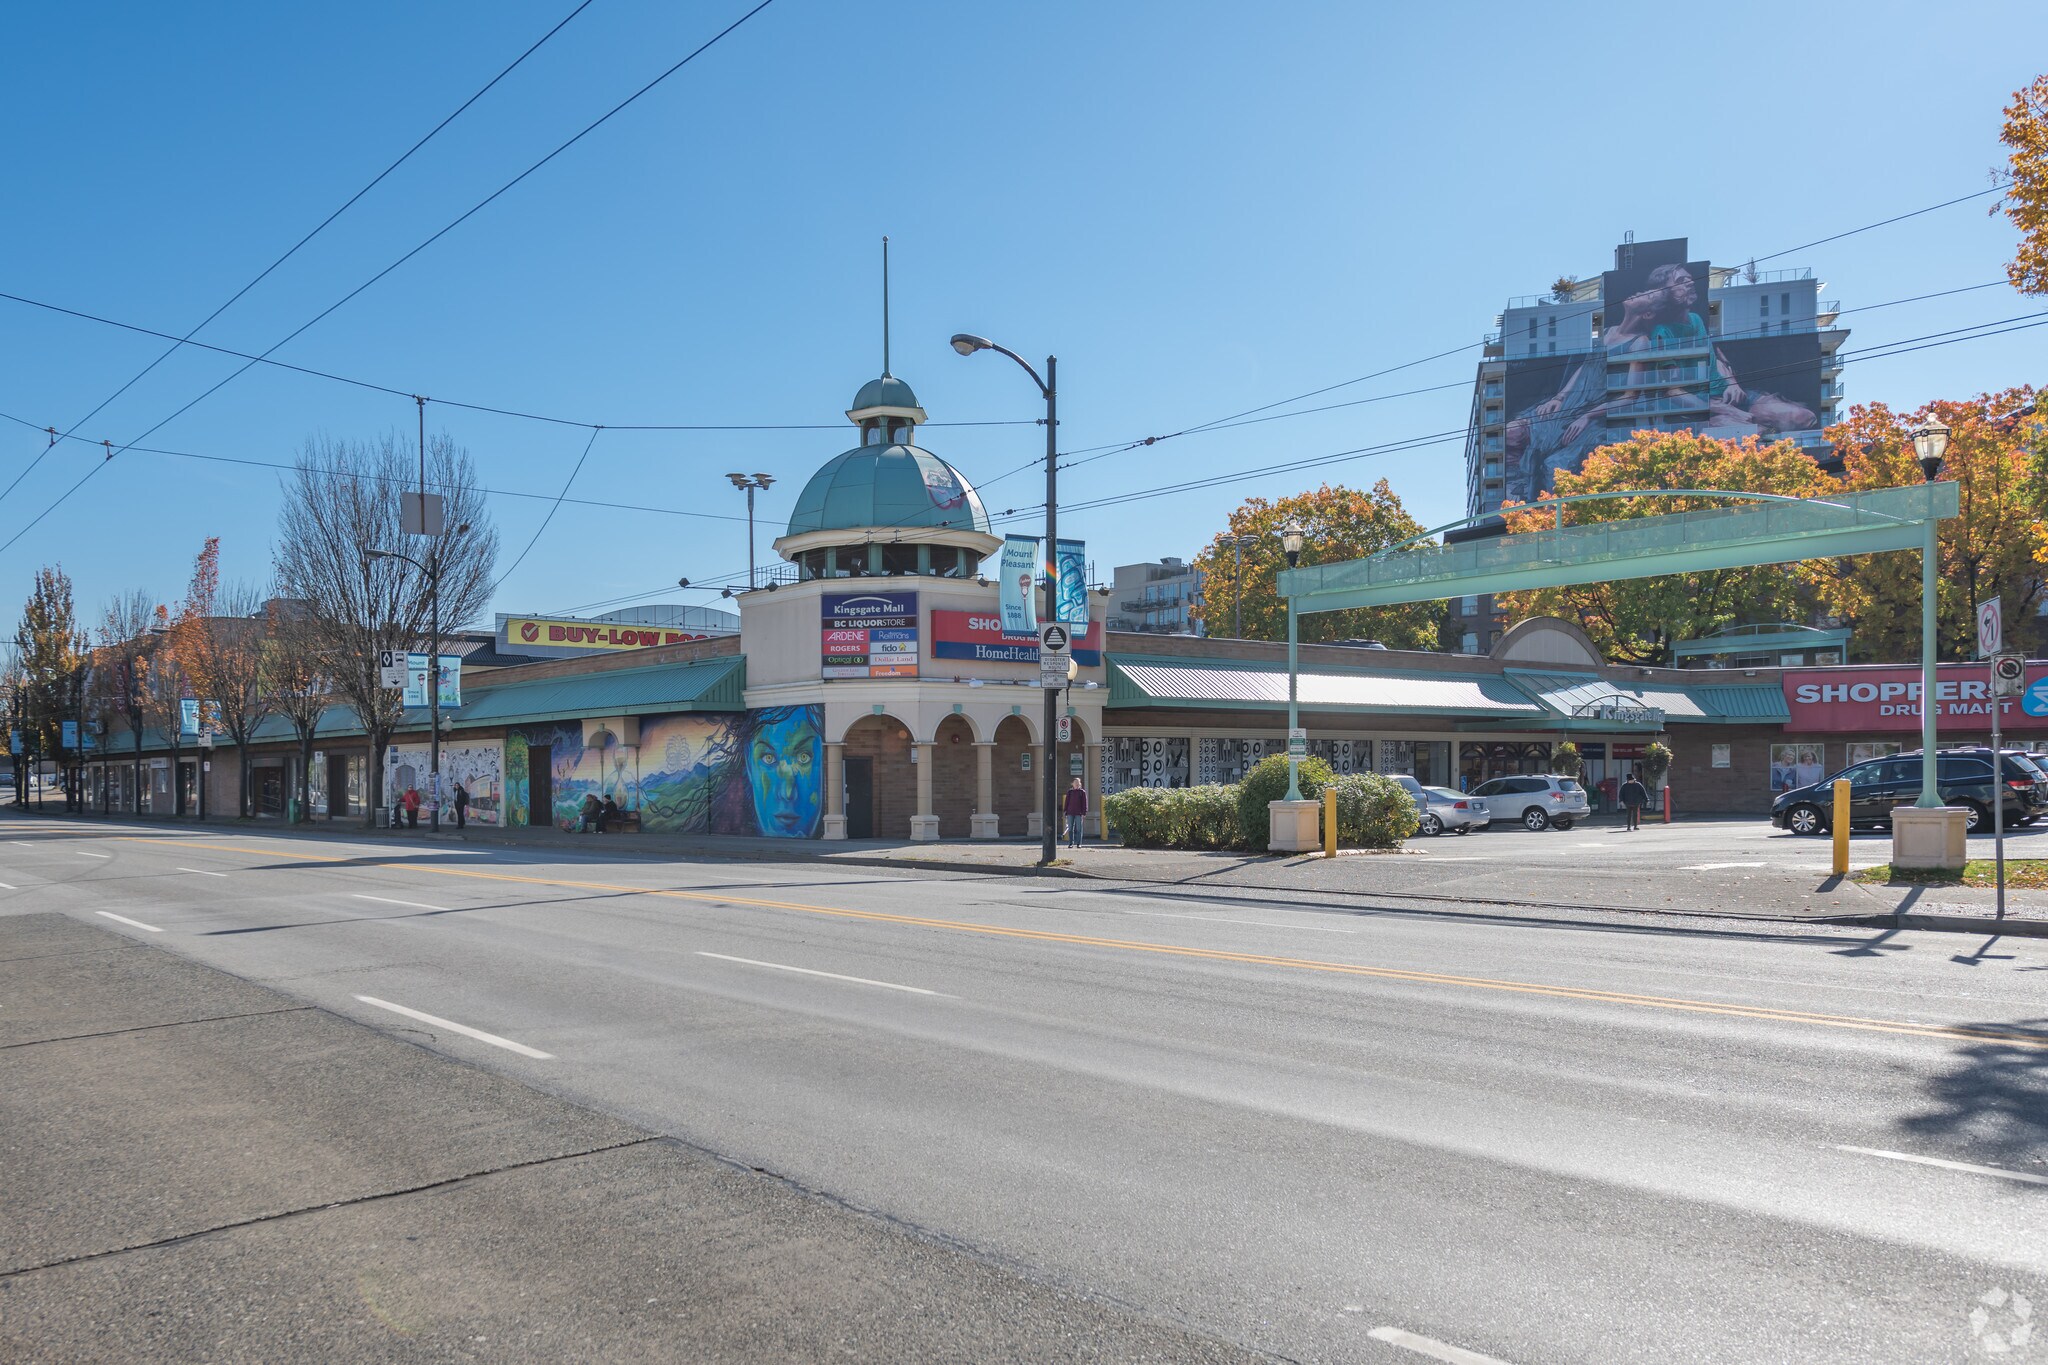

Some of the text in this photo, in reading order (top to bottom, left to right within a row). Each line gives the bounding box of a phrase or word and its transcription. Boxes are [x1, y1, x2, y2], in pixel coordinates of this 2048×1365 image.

[1006, 549, 1033, 558] Mount
[1001, 559, 1035, 569] Pleasant
[834, 604, 904, 616] Kingsgate Mall
[834, 620, 847, 628] BC
[549, 625, 660, 647] BUY-LOW
[827, 631, 864, 641] ARDENE
[882, 644, 898, 652] fido
[828, 656, 852, 664] Optical
[1604, 705, 1651, 723] Kingsgate
